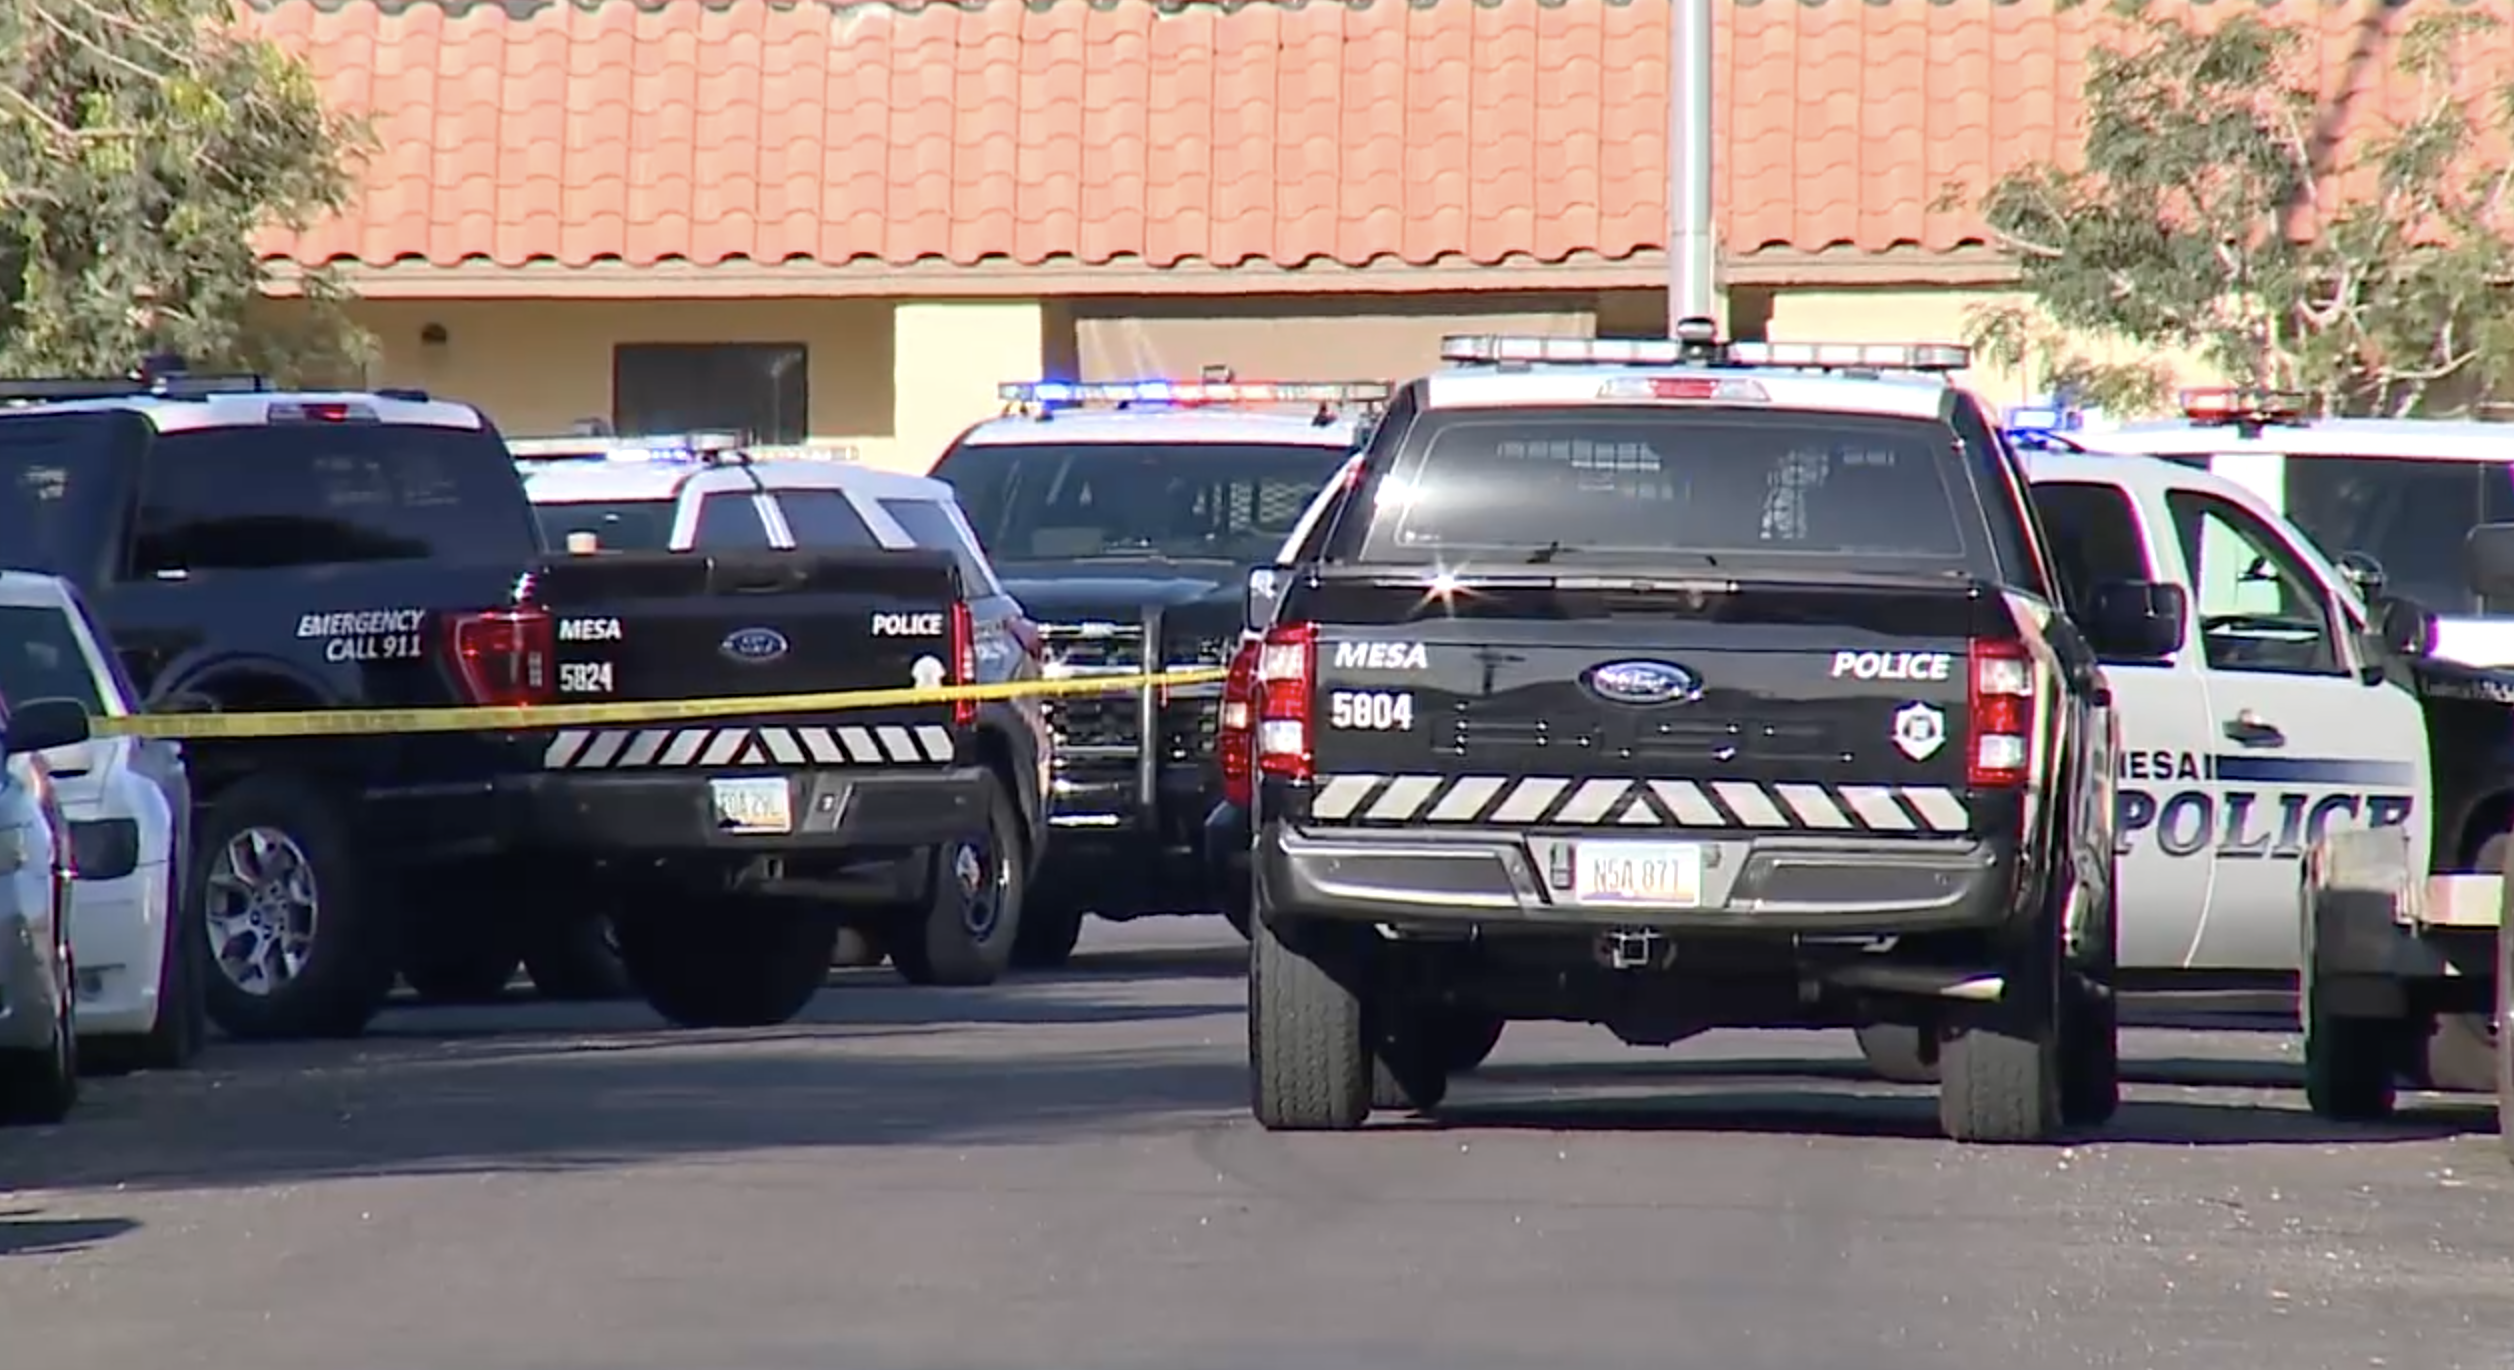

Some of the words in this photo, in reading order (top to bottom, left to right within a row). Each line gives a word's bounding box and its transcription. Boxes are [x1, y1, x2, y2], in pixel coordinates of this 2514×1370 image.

[297, 607, 426, 637] EMERGENCY
[558, 618, 622, 640] MESA
[871, 613, 943, 636] POLICE
[326, 637, 378, 661] CALL
[383, 634, 422, 658] 911
[1334, 641, 1428, 669] MESA
[559, 662, 614, 692] 5824
[1831, 651, 1951, 679] POLICE
[1331, 692, 1413, 730] 5804
